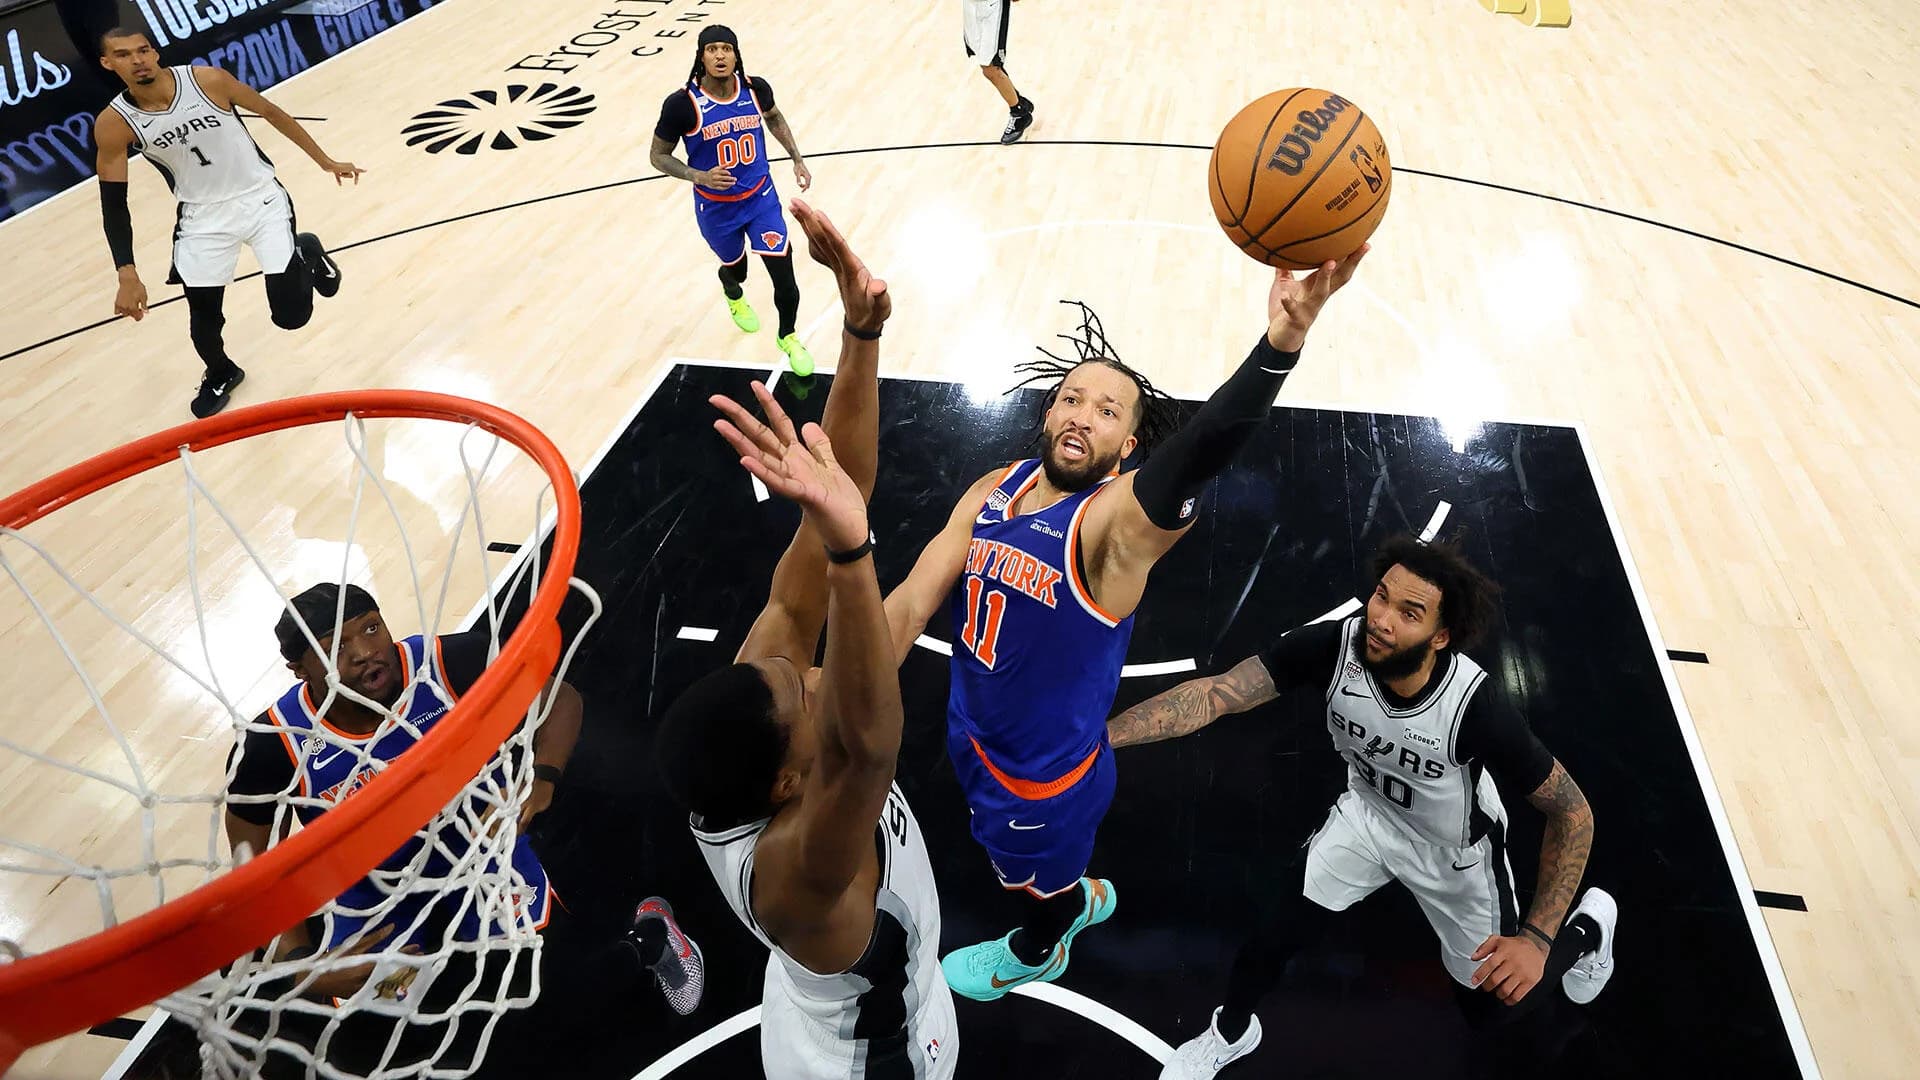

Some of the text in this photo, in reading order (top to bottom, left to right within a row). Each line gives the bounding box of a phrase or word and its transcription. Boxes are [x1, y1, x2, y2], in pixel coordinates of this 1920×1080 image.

[504, 9, 657, 74] Frost
[153, 115, 222, 149] SPURS
[702, 115, 761, 141] NEW YORK
[717, 133, 756, 170] 00
[190, 146, 212, 167] 1
[987, 541, 1063, 610] YORK
[961, 574, 1007, 671] 11
[1331, 710, 1445, 779] SPURS
